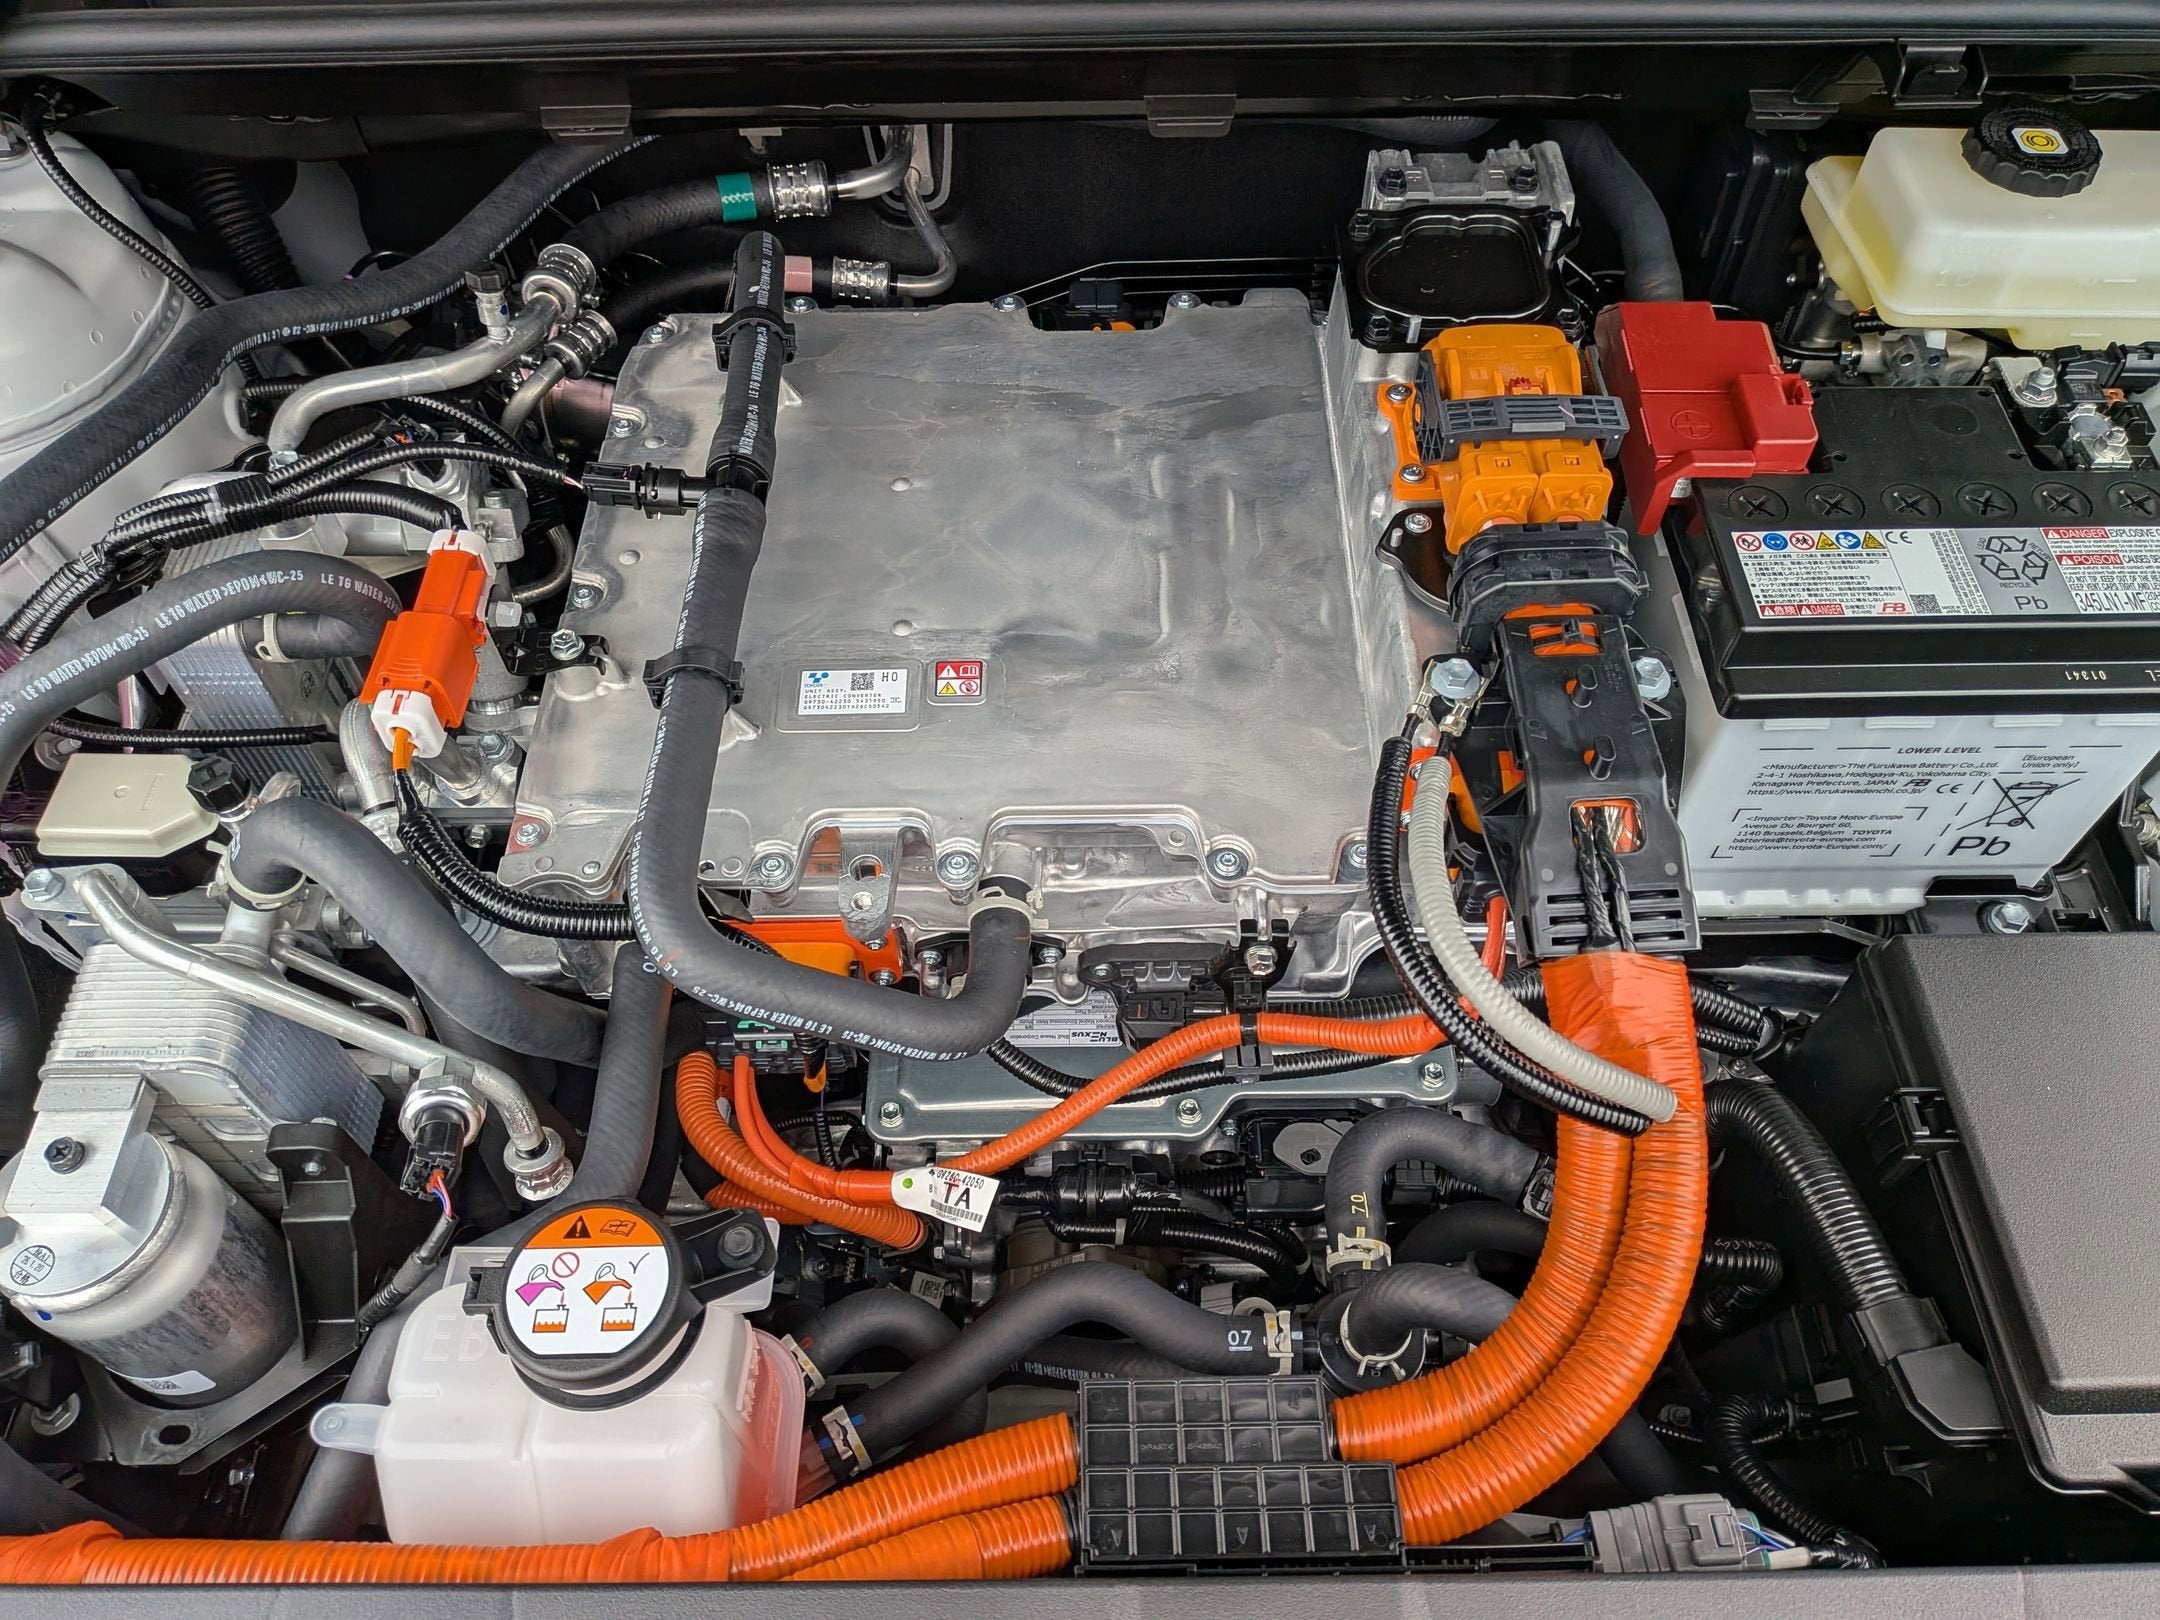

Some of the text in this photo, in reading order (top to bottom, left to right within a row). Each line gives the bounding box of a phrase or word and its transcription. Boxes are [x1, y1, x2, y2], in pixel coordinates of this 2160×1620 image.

[2059, 530, 2107, 538] DANGER
[2110, 529, 2155, 537] EXPLOSIVE
[2073, 556, 2121, 564] POISON
[2123, 555, 2149, 563] CAUSES
[321, 573, 334, 585] LE
[354, 581, 384, 600] WATER
[154, 610, 172, 628] LE
[183, 588, 221, 612] WATER
[1811, 605, 1843, 615] DANGER
[2014, 596, 2048, 610] Pb
[2075, 592, 2146, 611] 345LN1-MF
[20, 684, 38, 700] LE
[47, 659, 84, 684] WATER
[1947, 836, 2012, 857] Pb
[818, 1024, 832, 1034] LE
[944, 1181, 971, 1210] TA
[1228, 1330, 1252, 1346] 07
